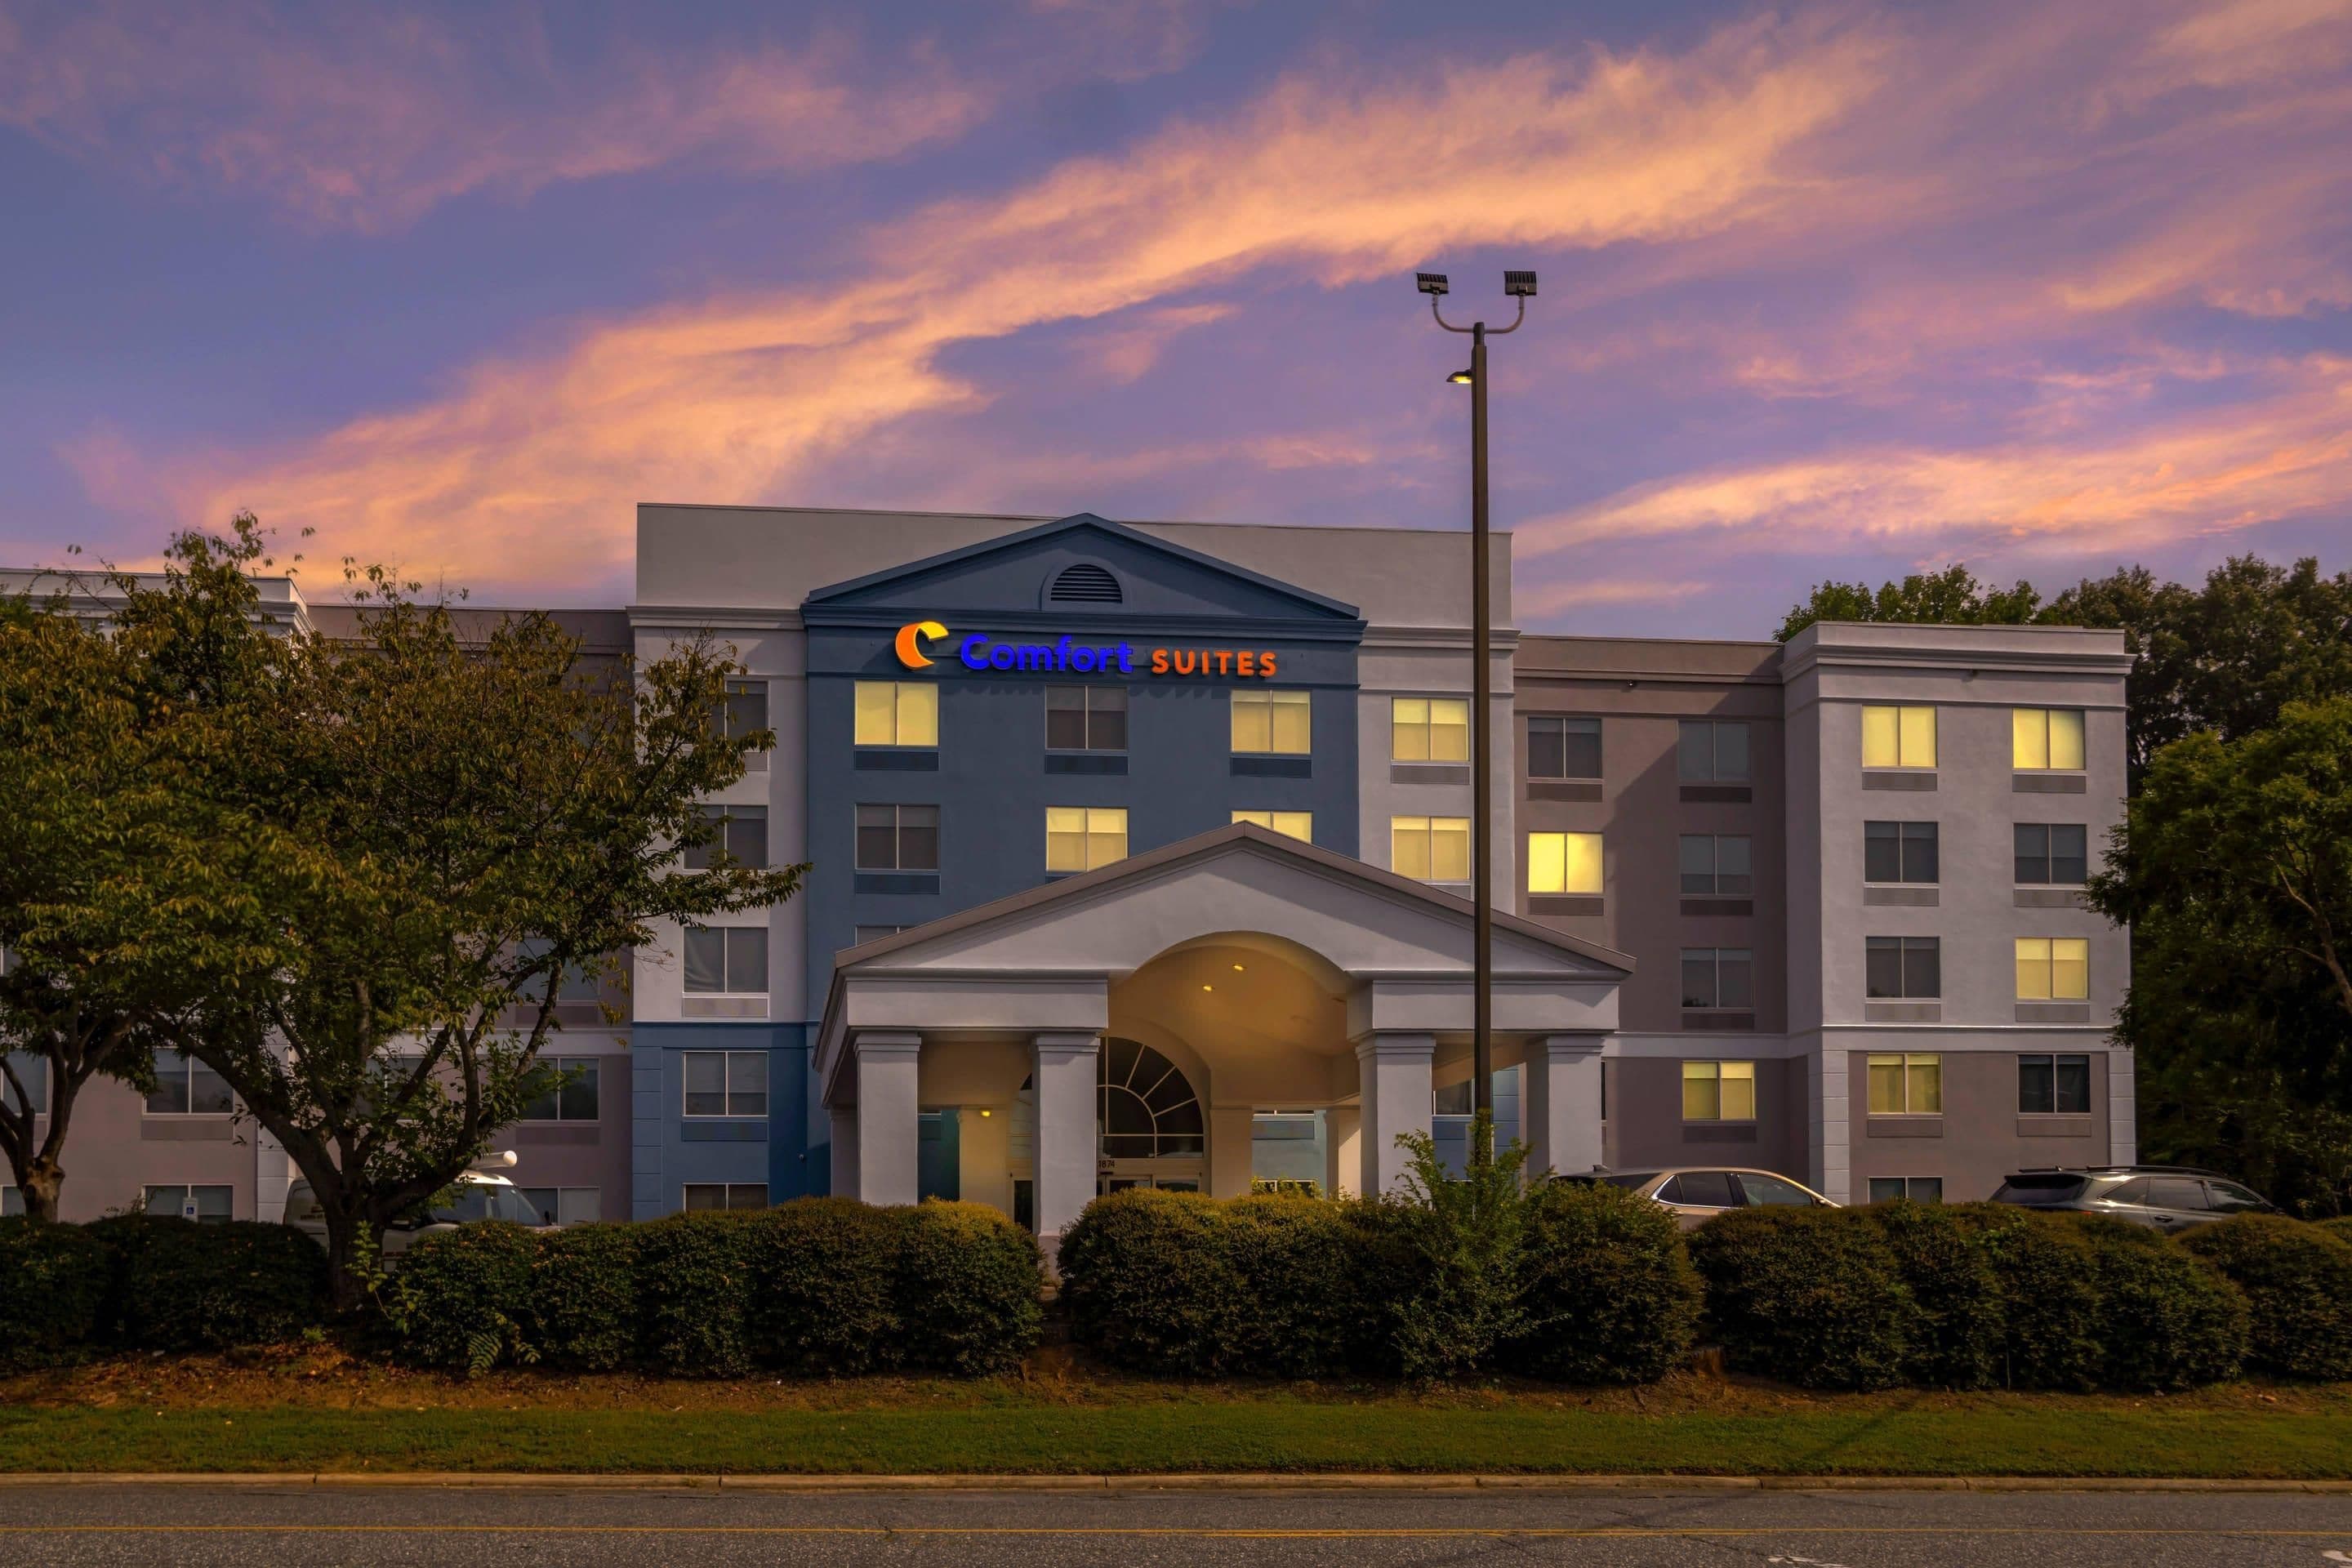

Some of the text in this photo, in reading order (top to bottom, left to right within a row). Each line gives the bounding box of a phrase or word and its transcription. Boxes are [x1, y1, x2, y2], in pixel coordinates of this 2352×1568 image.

[960, 633, 1276, 677] Comfort SUITES
[1098, 1160, 1115, 1169] 1874
